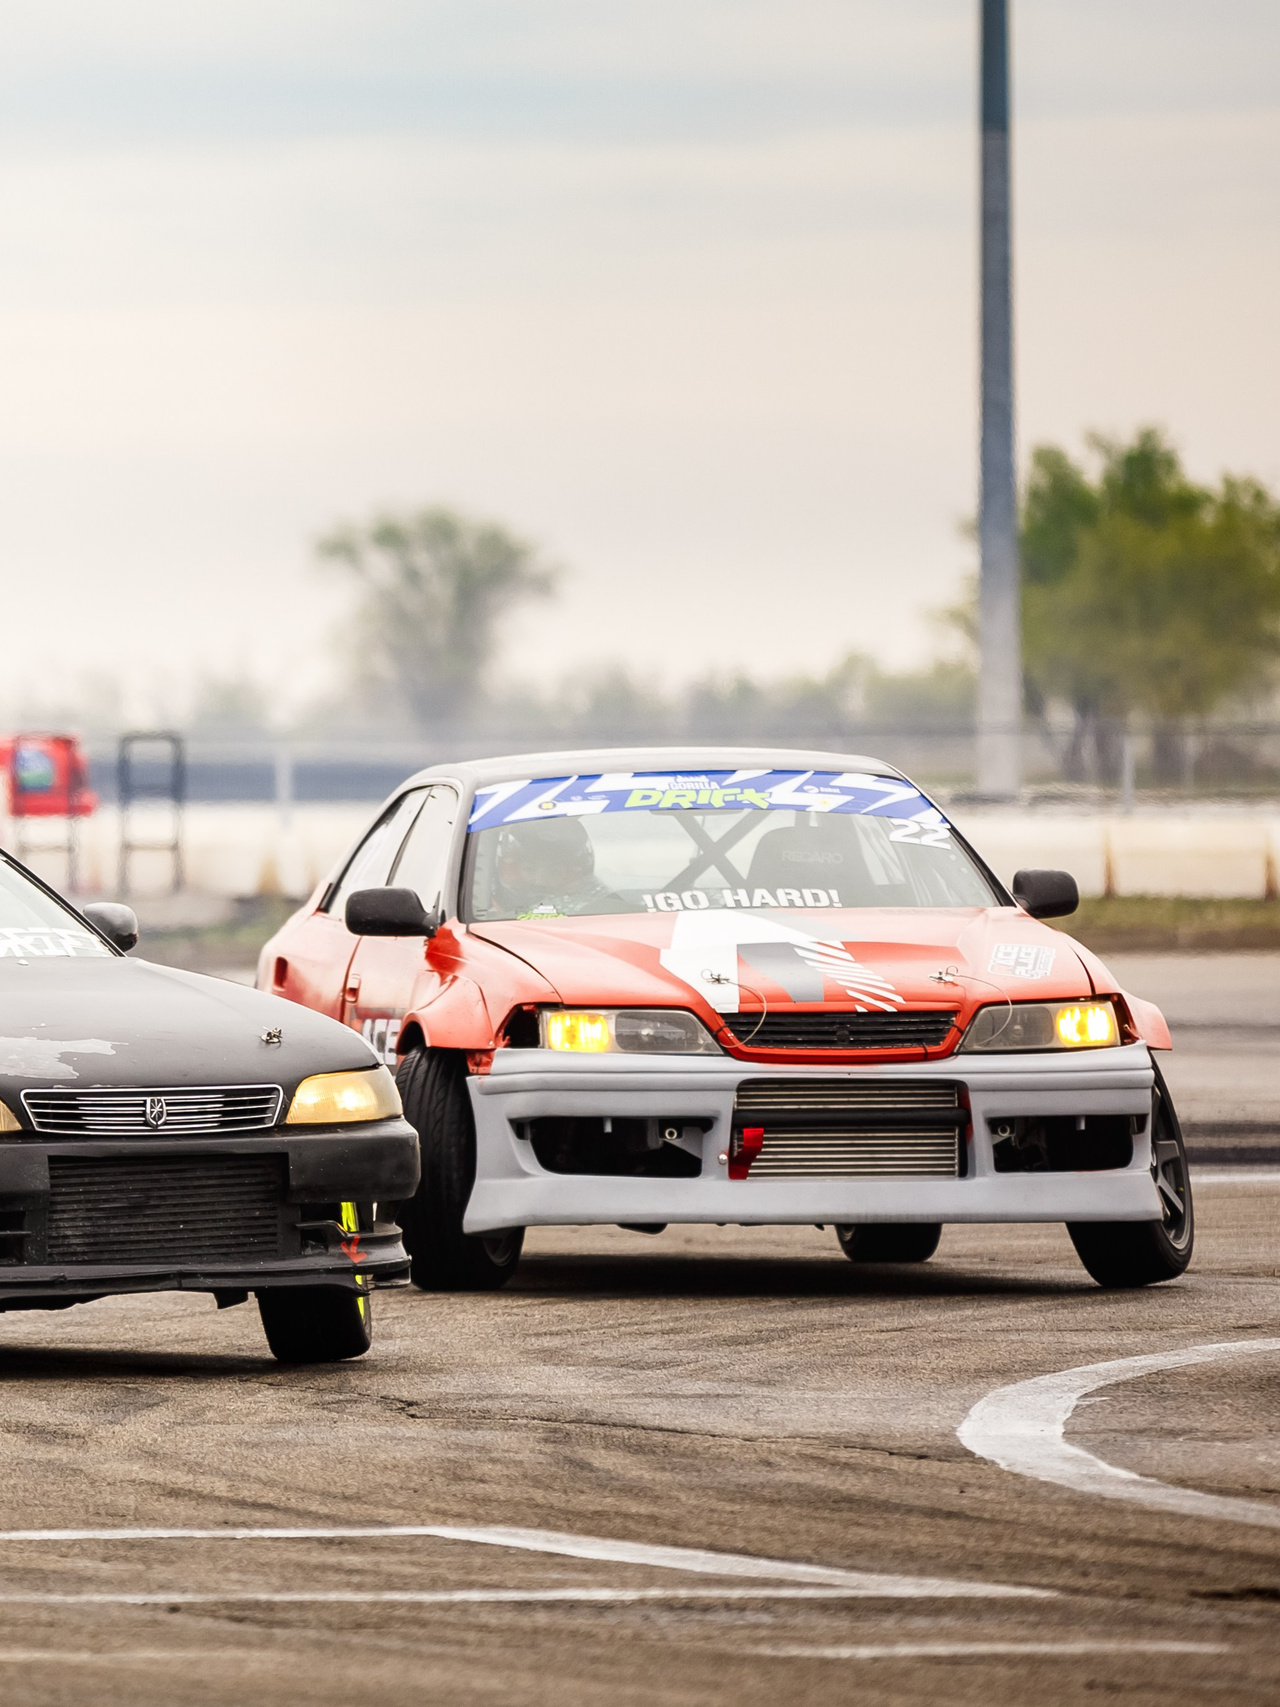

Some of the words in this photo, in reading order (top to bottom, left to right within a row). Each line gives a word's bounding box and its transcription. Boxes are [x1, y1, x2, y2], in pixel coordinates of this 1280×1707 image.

[624, 788, 771, 809] DRIFT
[889, 818, 951, 850] 22
[782, 850, 844, 864] RECARO
[642, 890, 710, 913] !GO
[722, 888, 843, 908] HARD!
